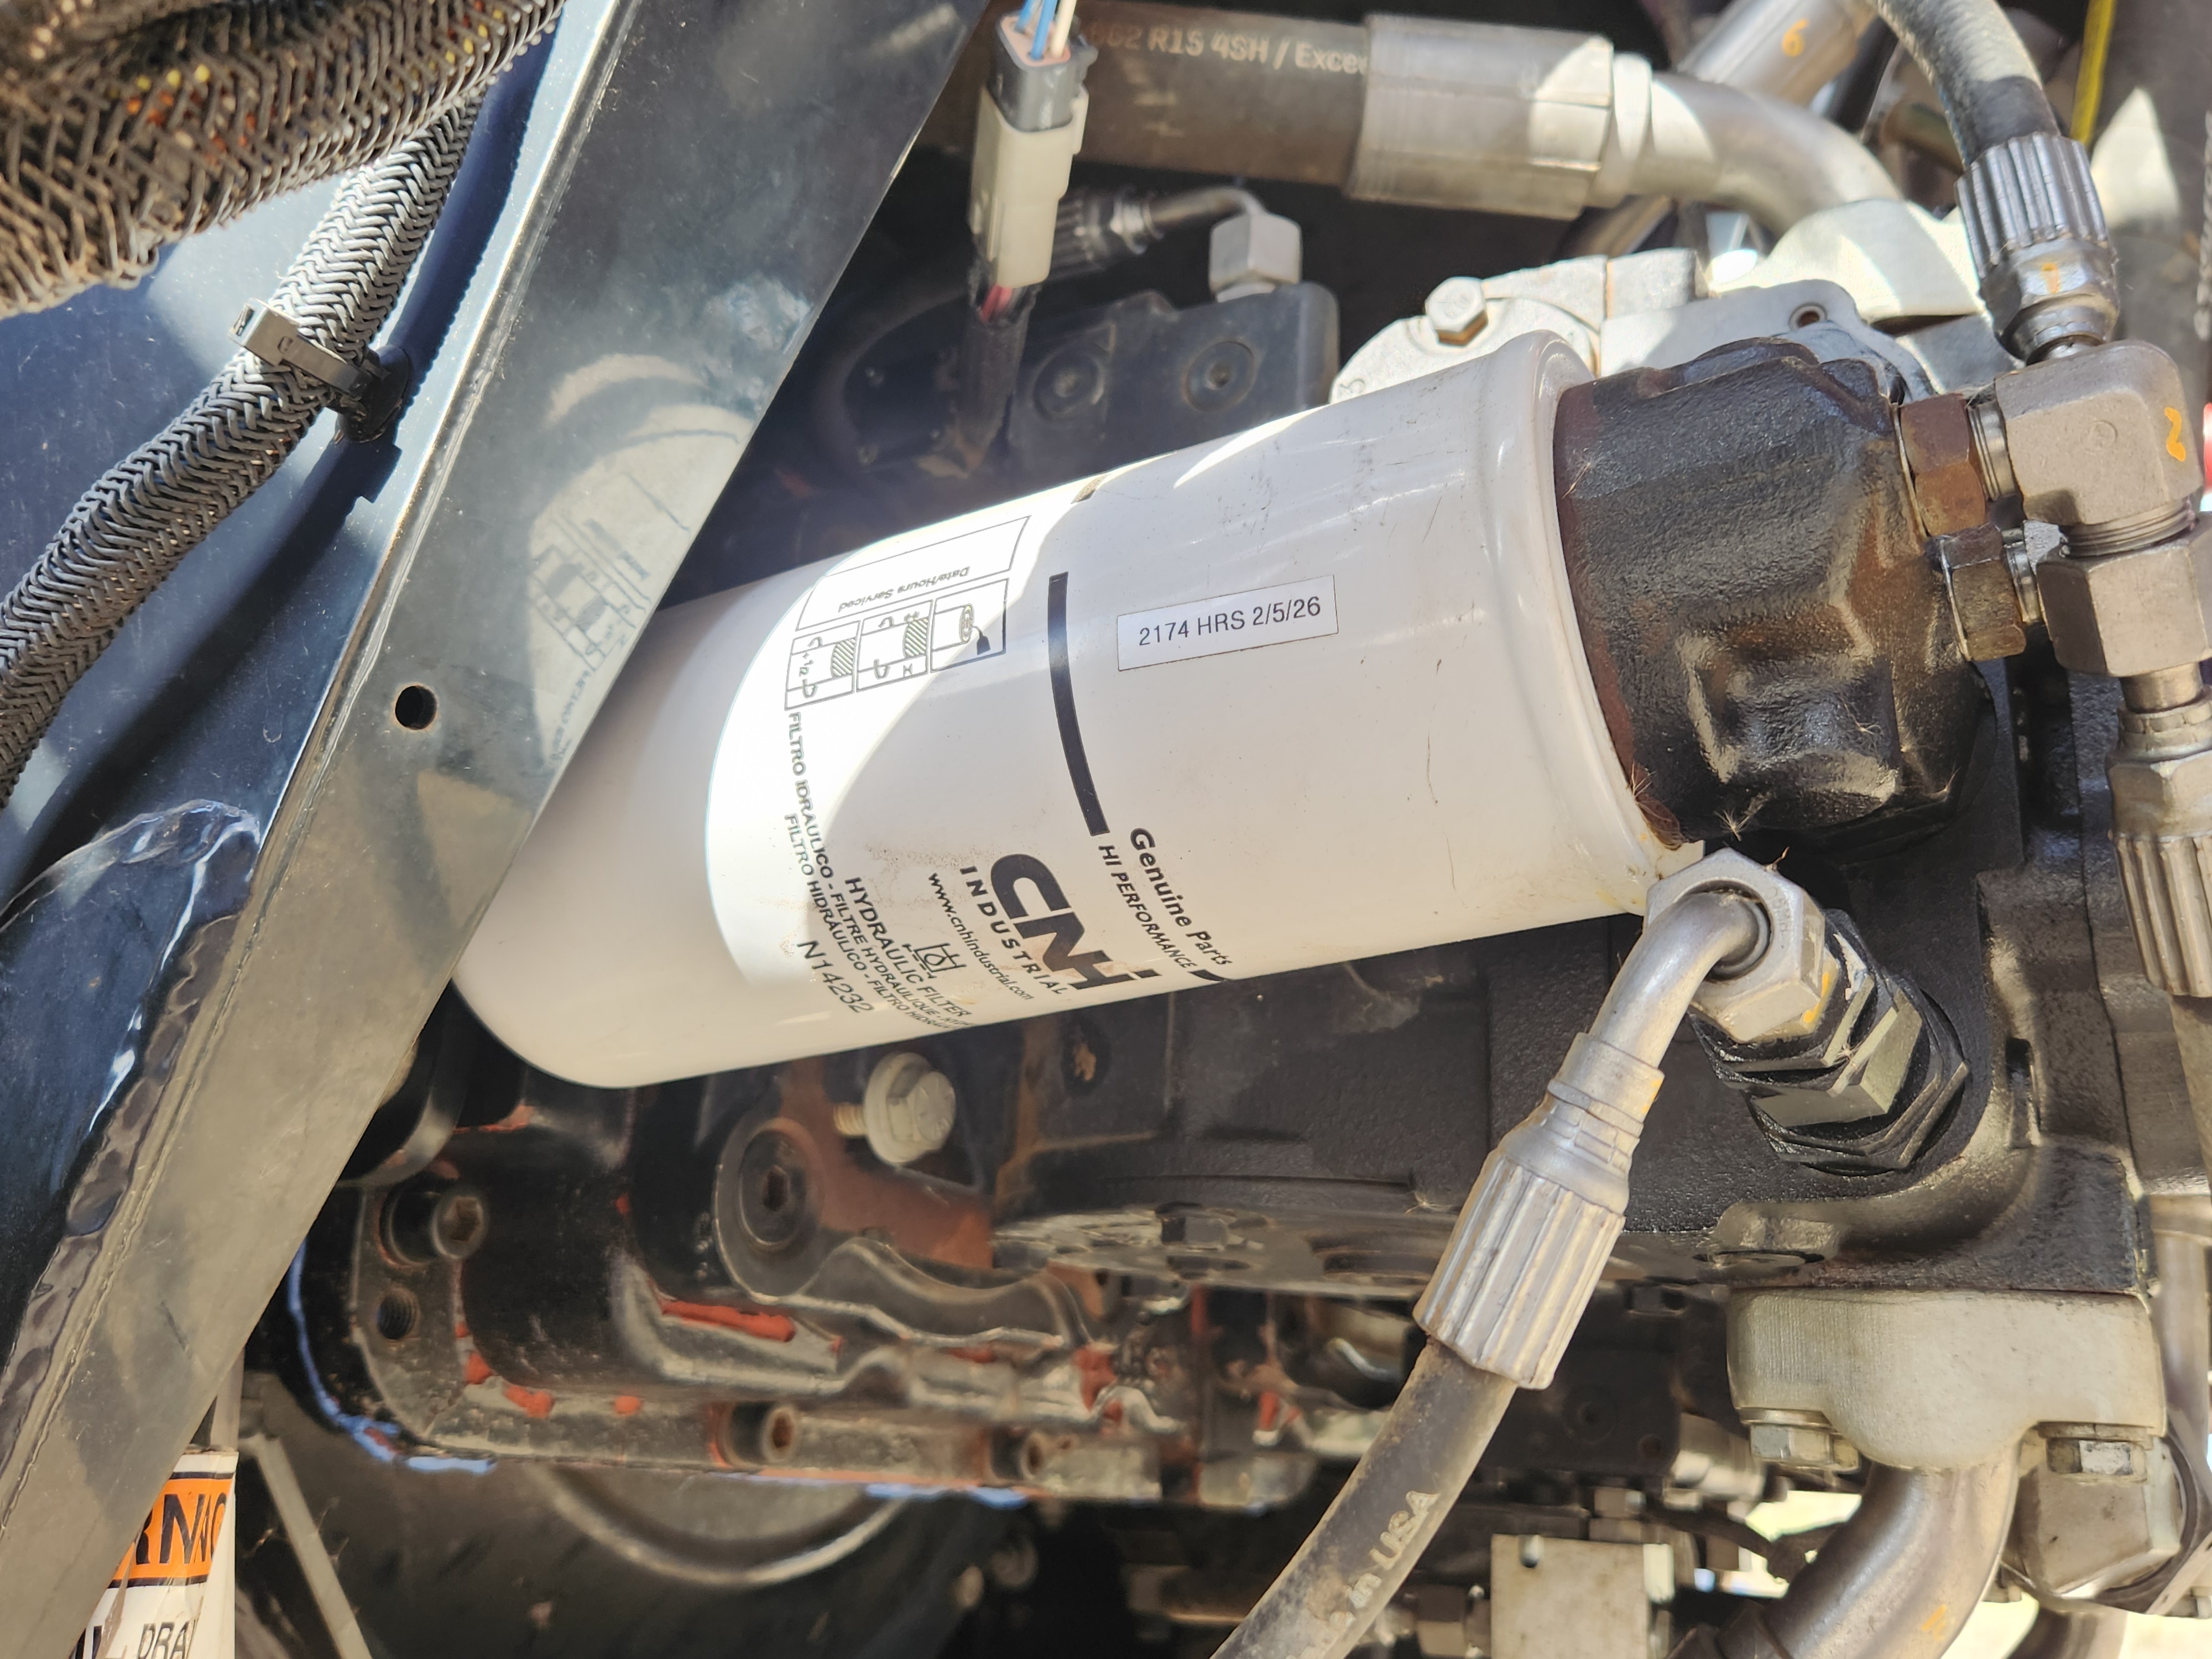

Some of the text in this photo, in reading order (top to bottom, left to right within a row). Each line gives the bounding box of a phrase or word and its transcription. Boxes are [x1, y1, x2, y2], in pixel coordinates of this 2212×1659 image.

[1148, 26, 1204, 56] R15
[1211, 31, 1269, 64] 4SH
[838, 566, 971, 613] Date/Hours Serviced
[1139, 596, 1321, 646] 2174 HRS 2/5/26
[789, 711, 806, 776] FILTRO
[795, 779, 834, 878] IDRAULICO
[784, 813, 815, 875] FILTRO
[867, 980, 911, 1010] FILTRO
[831, 893, 868, 945] FILTRE
[928, 873, 1034, 1000] www.cnhindustrial.com
[959, 866, 1068, 994] INDUSTRIAL
[990, 854, 1162, 990] CNH
[1098, 845, 1198, 968] HI PERFORMANCE
[1130, 828, 1233, 965] Genuine Parts
[796, 940, 875, 1014] N14232
[844, 877, 973, 1016] HYDRAULIC FILTER
[860, 947, 941, 1015] HYDRAULIQUE
[1370, 1490, 1440, 1570] USA
